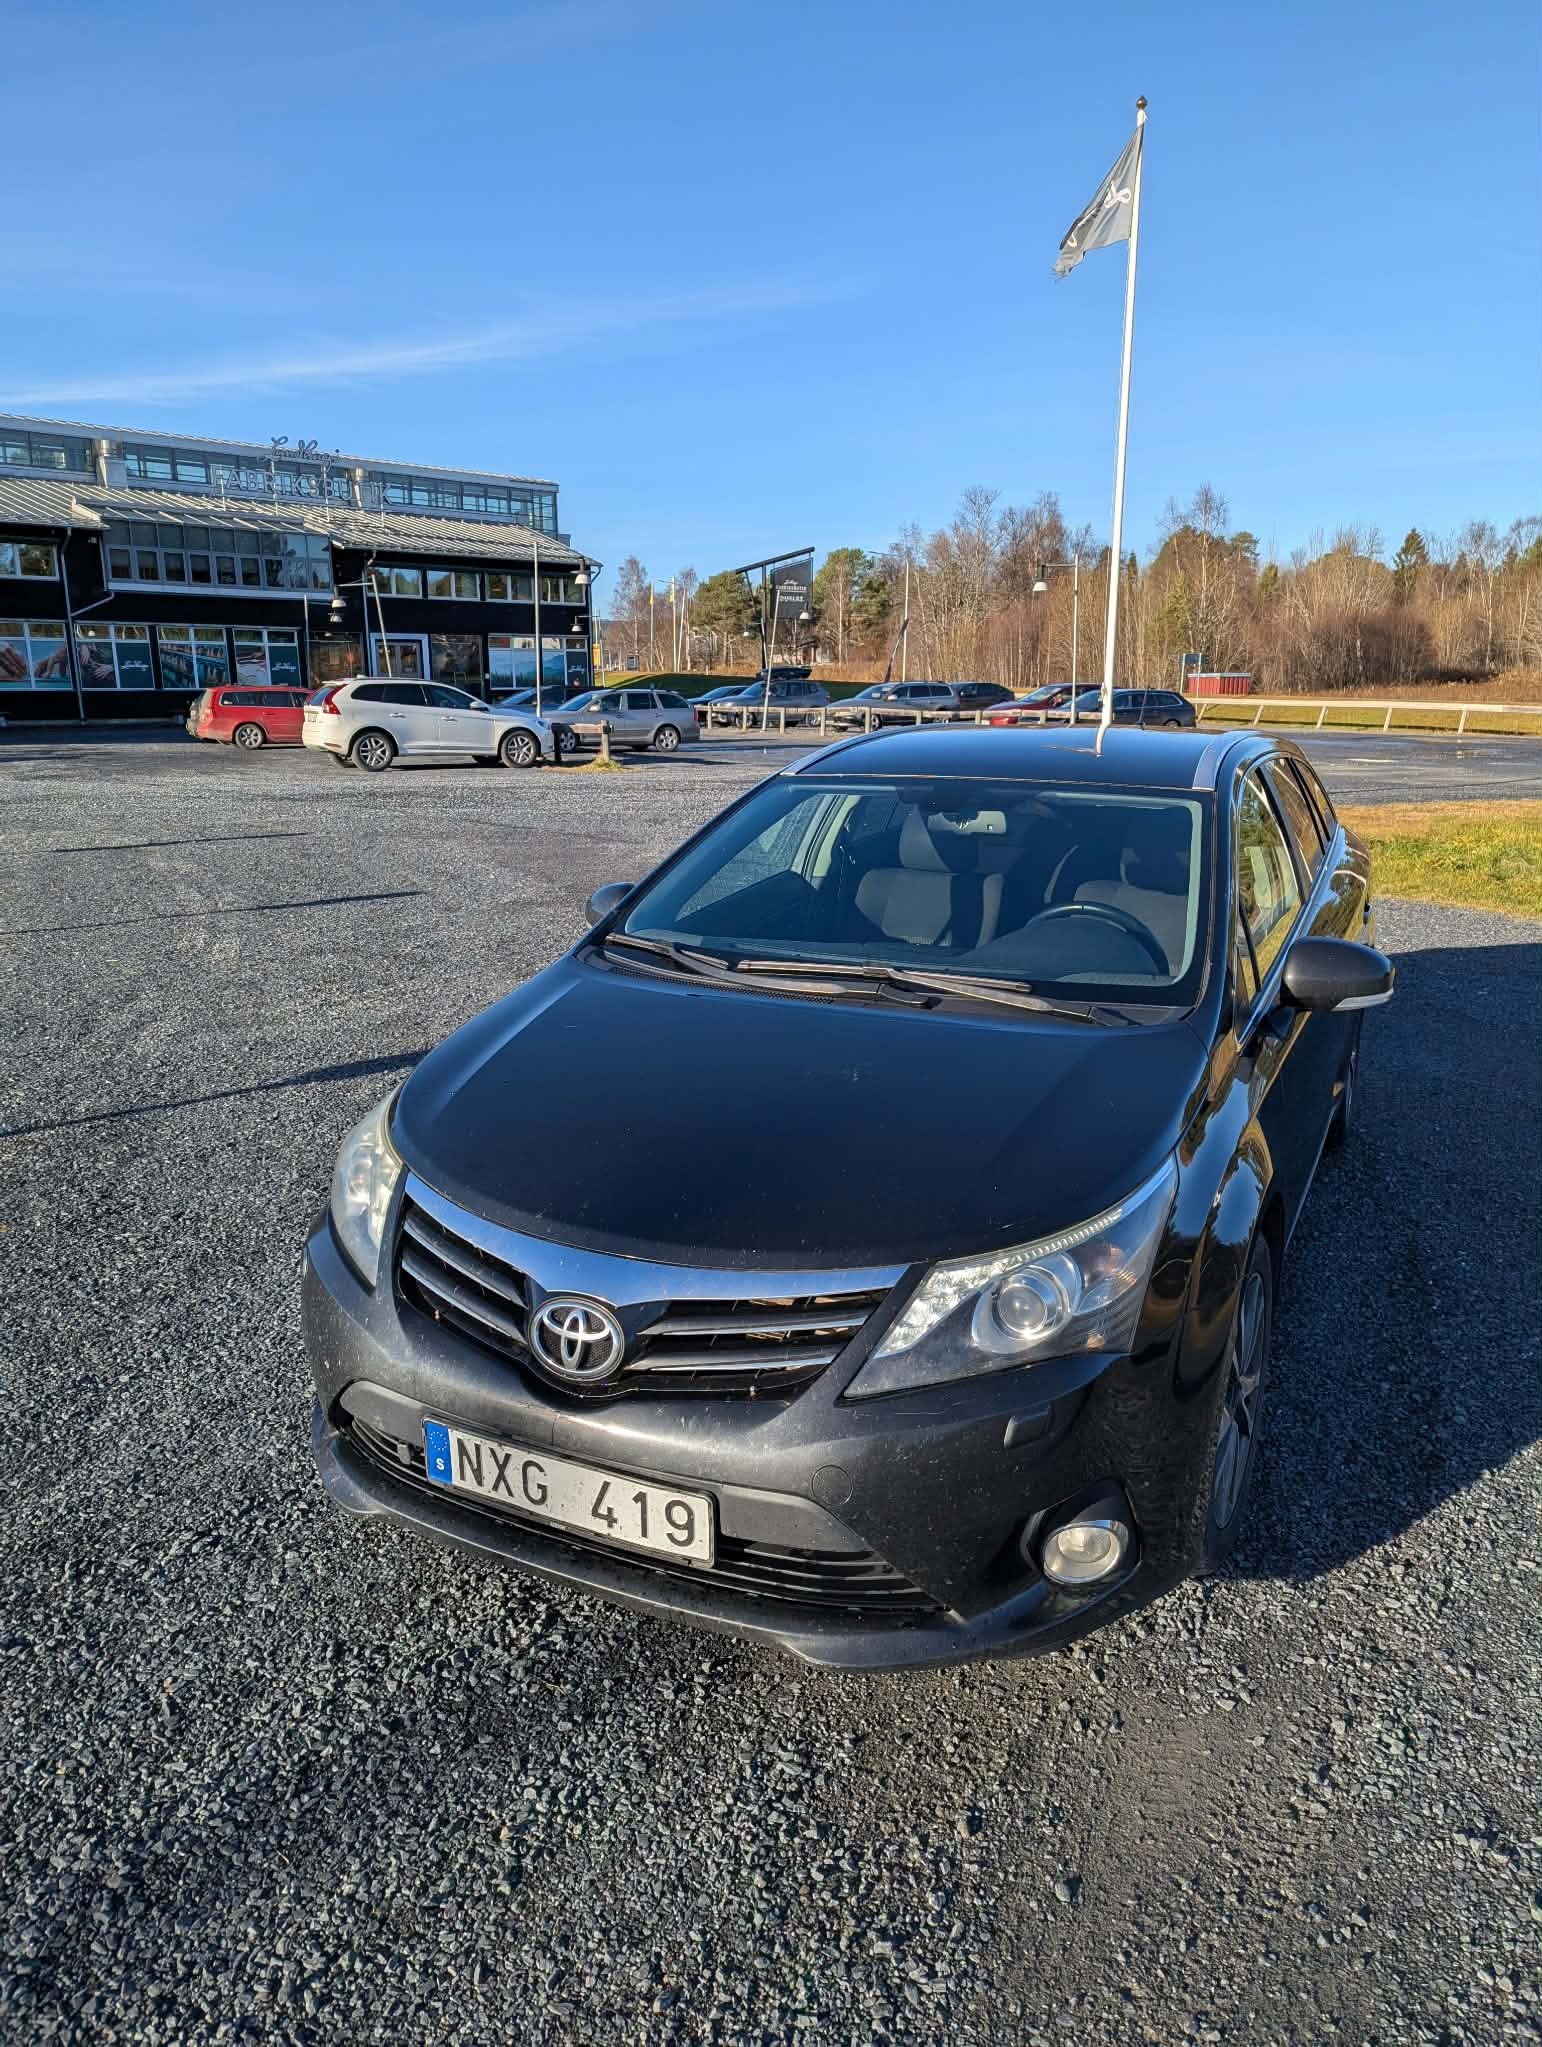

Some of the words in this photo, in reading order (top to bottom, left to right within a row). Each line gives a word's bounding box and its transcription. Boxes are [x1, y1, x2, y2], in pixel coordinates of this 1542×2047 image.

[210, 464, 392, 505] FABRIKSBUIK
[436, 1457, 445, 1471] S
[456, 1437, 549, 1507] NXG
[591, 1480, 696, 1548] 419
